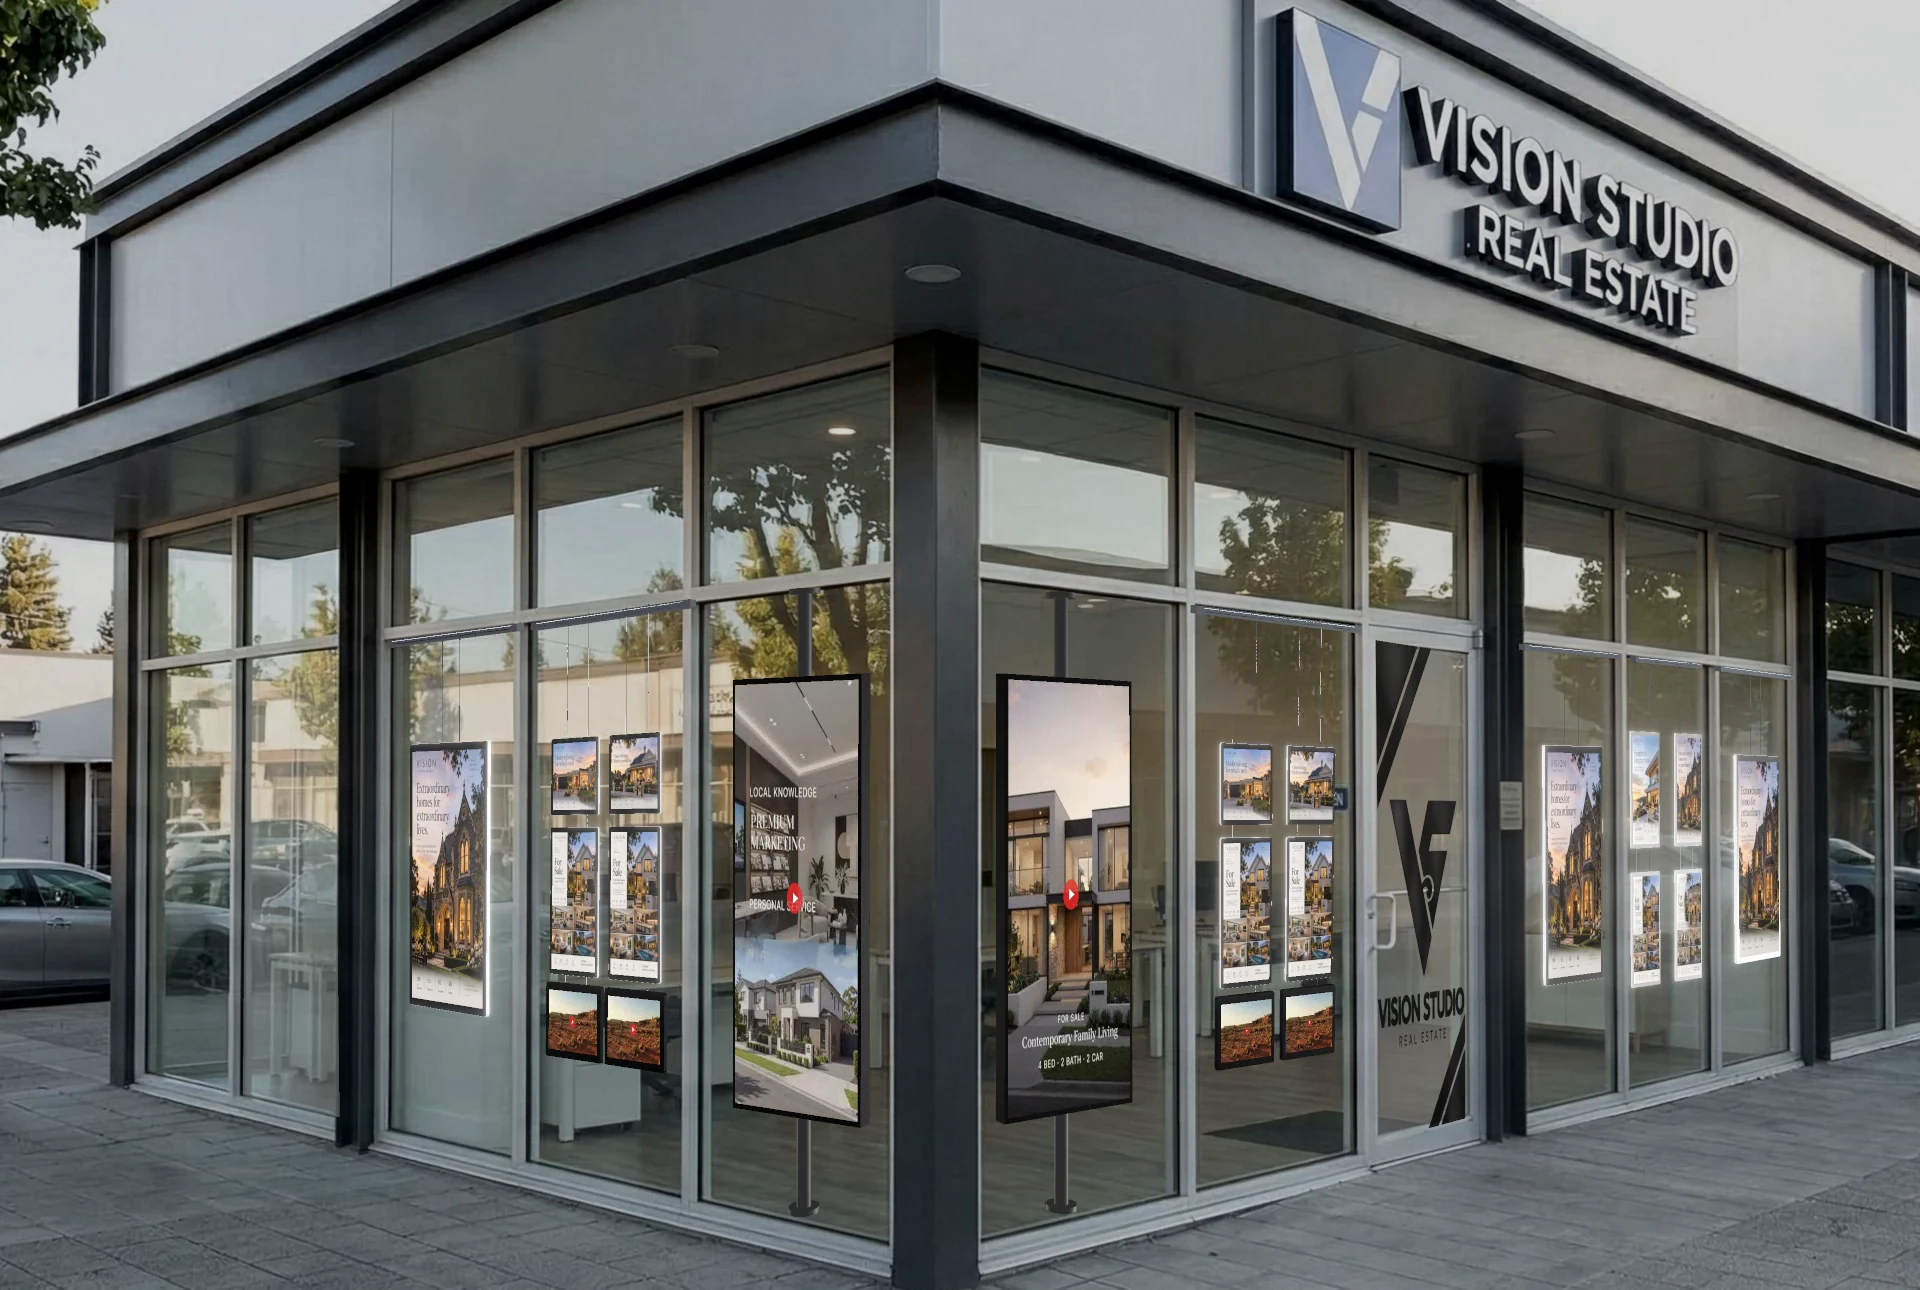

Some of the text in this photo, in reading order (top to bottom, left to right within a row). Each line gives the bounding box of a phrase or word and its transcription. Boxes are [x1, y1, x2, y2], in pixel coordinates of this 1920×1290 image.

[1414, 86, 1740, 288] VISION STUDIO
[1475, 205, 1698, 335] REAL ESTATE
[417, 782, 449, 796] Extraordinary
[749, 786, 817, 798] LOCAL KNOWLEDGE
[416, 795, 441, 808] homes for
[751, 815, 795, 829] PREMIUM
[750, 835, 806, 852] MARKETING
[554, 857, 562, 866] For
[1225, 869, 1235, 879] For
[749, 898, 786, 912] PERSONAL
[1378, 986, 1465, 1028] VISION STUDIO
[1058, 1012, 1084, 1023] FOR SALE
[1022, 1026, 1118, 1048] Contemporary Family Living
[1398, 1027, 1447, 1047] REAL ESTATE
[1038, 1052, 1104, 1069] 4 BED 2 BATH 2 CAR
